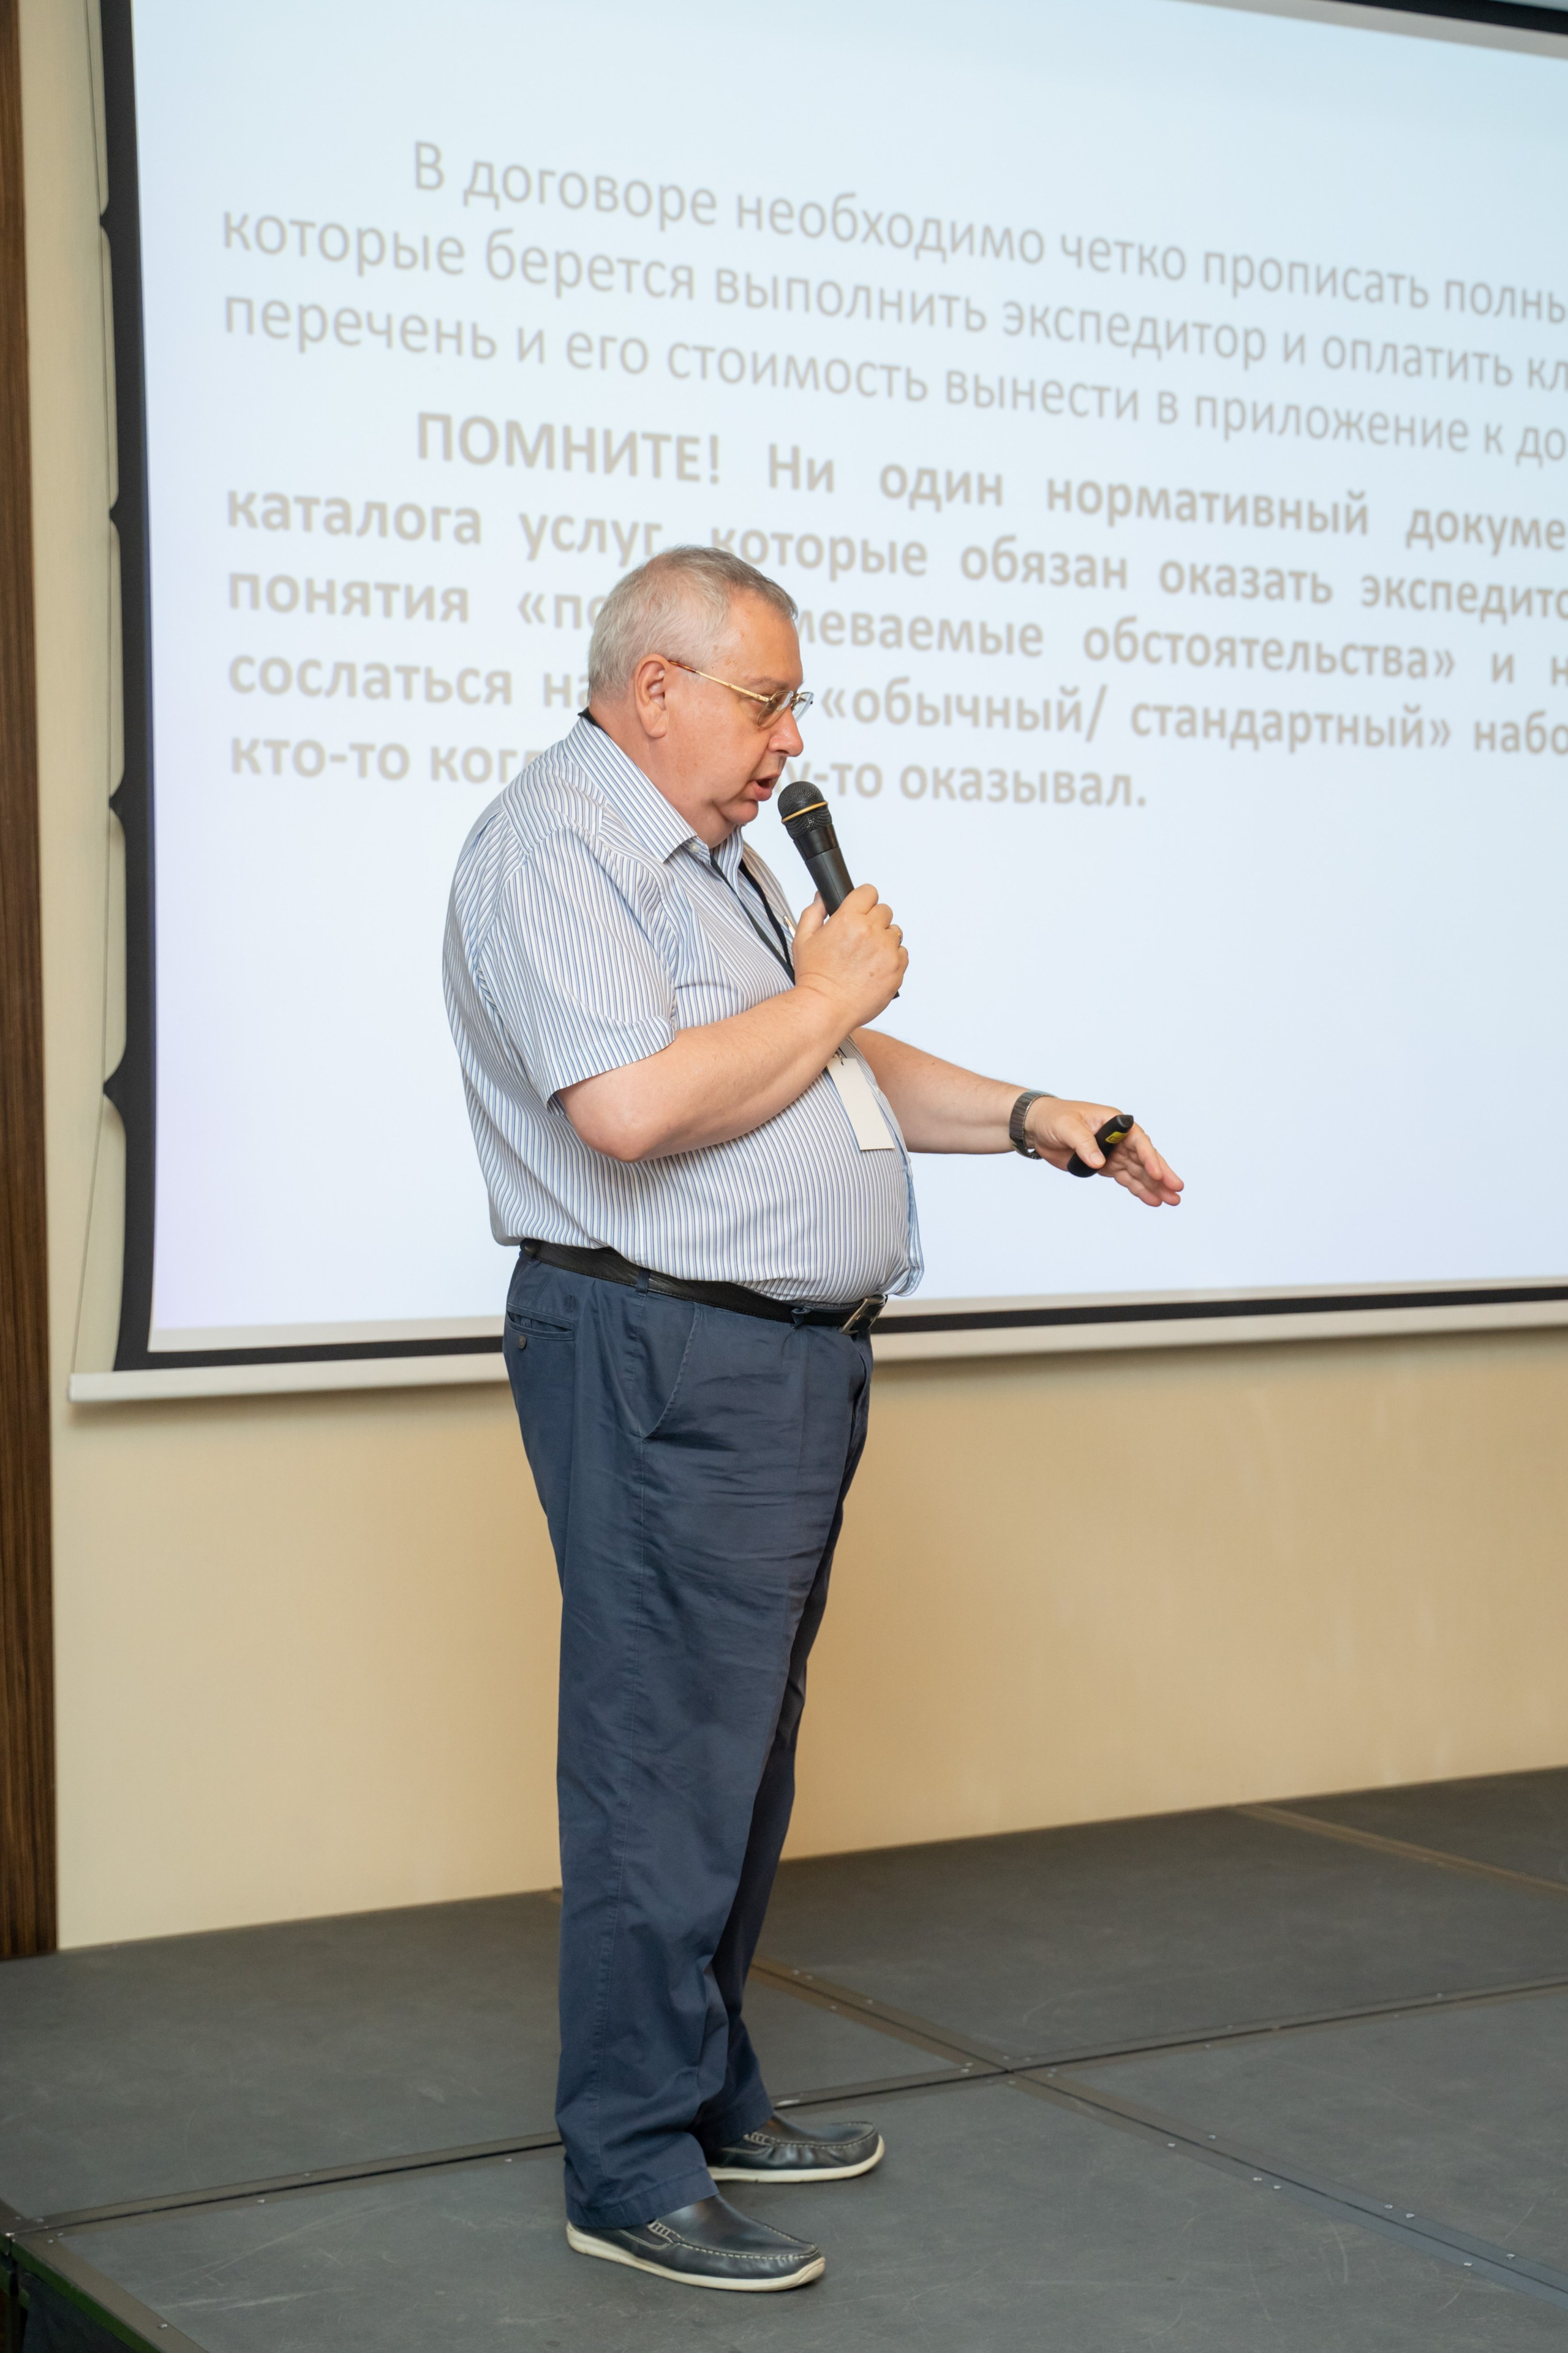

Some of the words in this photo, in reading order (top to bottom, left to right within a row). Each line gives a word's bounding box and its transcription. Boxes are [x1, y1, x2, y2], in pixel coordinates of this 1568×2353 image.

[415, 140, 445, 191] В
[464, 161, 717, 232] договоре
[738, 192, 1045, 263] необходимо
[1061, 235, 1187, 282] четко
[1204, 251, 1430, 309] прописать
[224, 211, 466, 277] которые
[486, 228, 695, 300] берется
[716, 268, 987, 333] выполнить
[1003, 300, 1267, 371] экспедитор
[1283, 332, 1305, 365] и
[1322, 335, 1513, 387] оплатить
[226, 296, 497, 360] перечень
[518, 327, 545, 364] и
[567, 332, 649, 375] его
[668, 342, 929, 402] стоимость
[946, 369, 1139, 421] вынести
[1158, 390, 1178, 425] в
[1196, 395, 1469, 453] приложение
[1484, 423, 1504, 455] к
[1515, 426, 1568, 467] до
[228, 490, 482, 545] каталога
[712, 527, 928, 583] которые
[961, 532, 1128, 589] обязан
[1159, 560, 1333, 605] оказать
[418, 412, 720, 486] ПОМНИТЕ!
[769, 443, 835, 493] Ни
[880, 464, 1003, 513] один
[1047, 478, 1368, 536] нормативный
[1405, 508, 1567, 557] докуме
[230, 572, 469, 623] понятия
[1084, 614, 1455, 680] обстоятельства»
[1491, 652, 1515, 684] и
[229, 655, 513, 707] сослаться
[1131, 703, 1451, 755] стандартный»
[1474, 709, 1568, 757] набо
[232, 738, 410, 781] кто-то
[900, 764, 1147, 808] оказывал.
